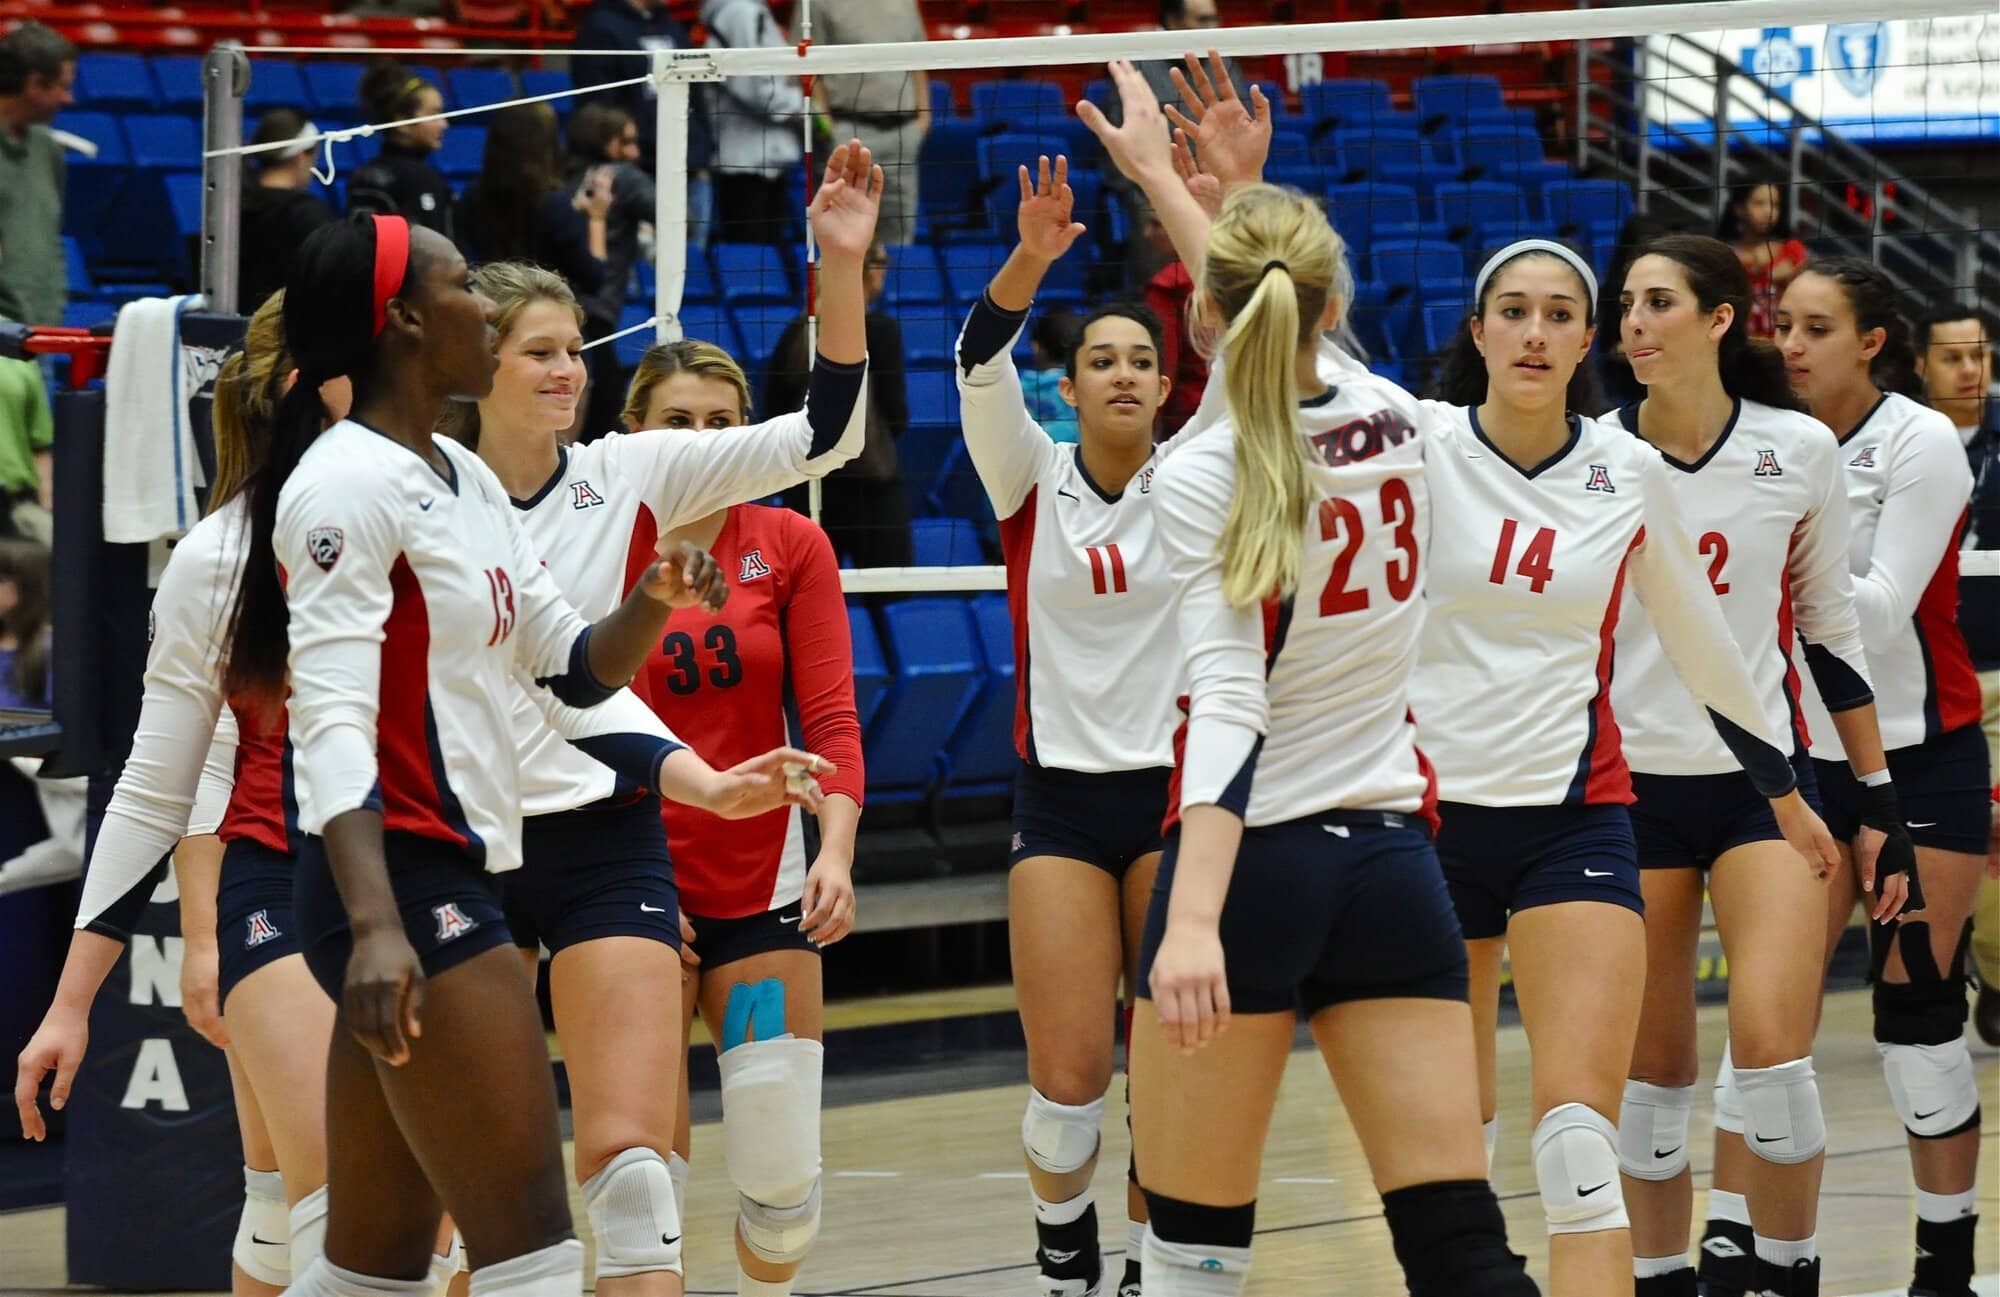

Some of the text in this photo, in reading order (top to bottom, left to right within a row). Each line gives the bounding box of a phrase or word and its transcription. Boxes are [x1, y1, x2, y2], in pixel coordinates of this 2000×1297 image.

[1755, 450, 1783, 476] A
[1849, 447, 1877, 468] A
[570, 480, 605, 510] A
[1586, 464, 1616, 494] A
[738, 549, 772, 583] A
[1319, 477, 1418, 617] 23
[1489, 518, 1557, 594] 14
[1085, 543, 1128, 595] 11
[483, 567, 516, 647] 13
[662, 624, 743, 695] 33
[246, 908, 283, 950] A
[431, 901, 480, 944] A
